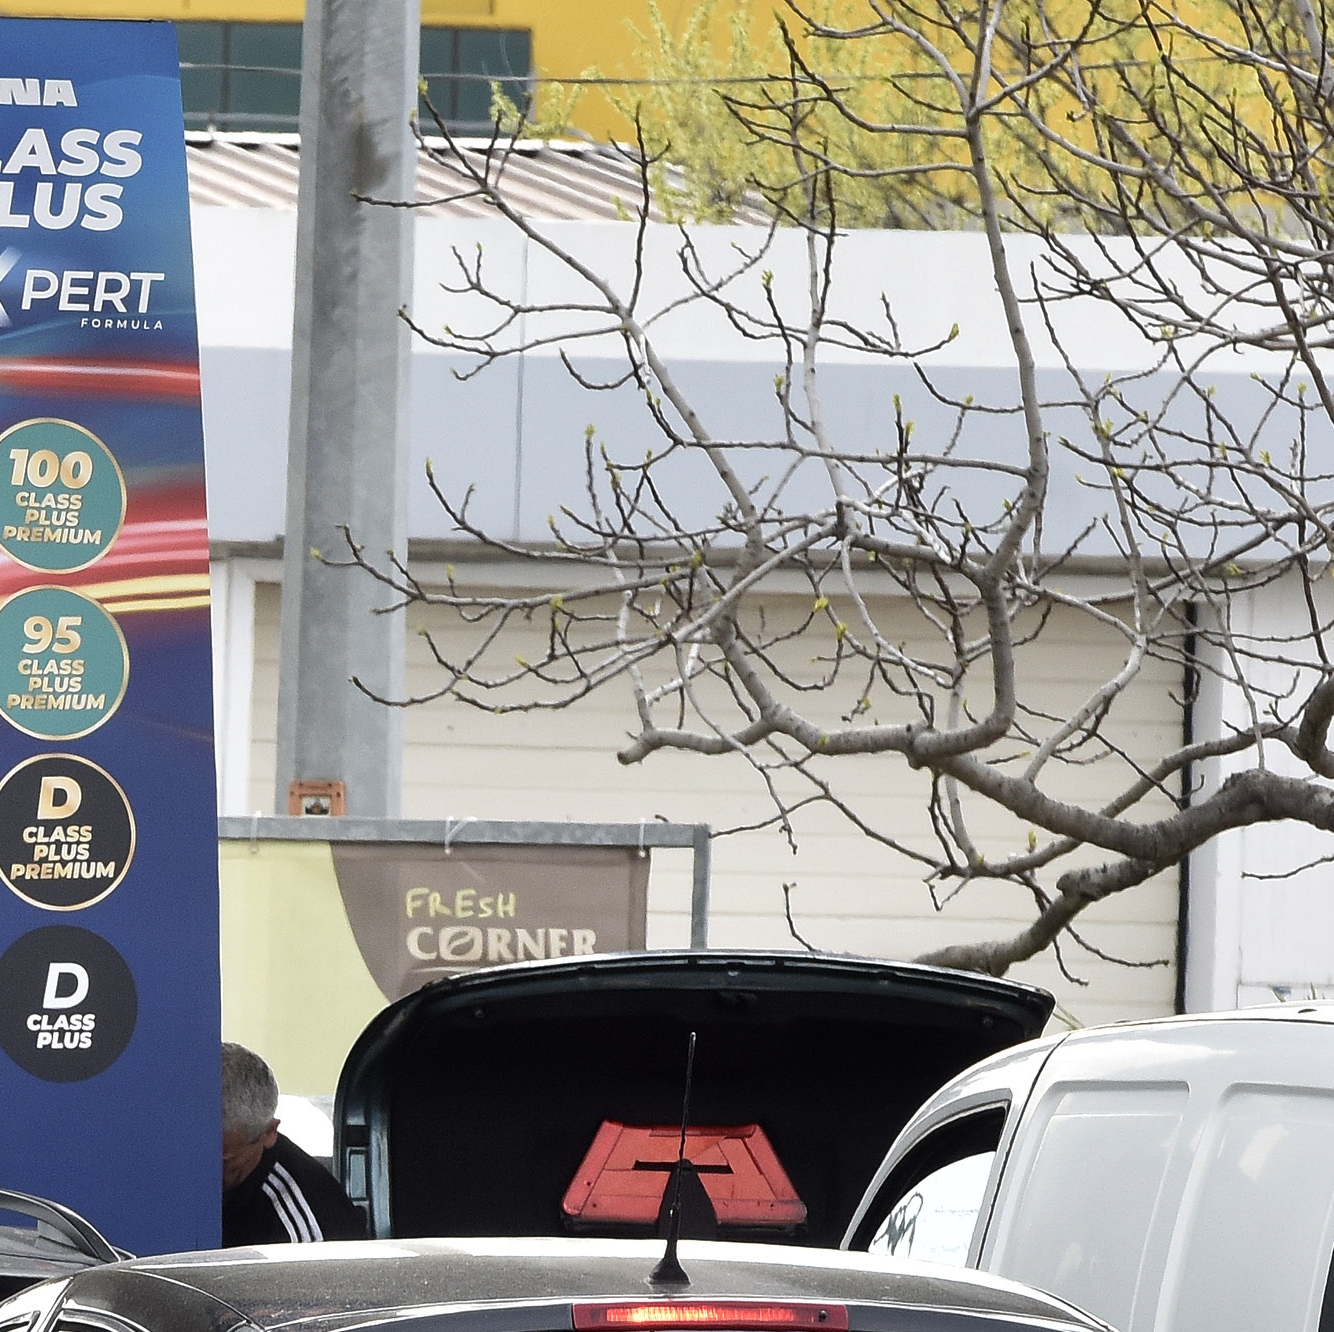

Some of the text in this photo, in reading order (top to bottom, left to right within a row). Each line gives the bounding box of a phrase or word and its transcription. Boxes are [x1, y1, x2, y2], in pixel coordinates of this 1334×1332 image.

[80, 317, 164, 330] FORMULA
[9, 448, 93, 489] 100
[15, 491, 83, 510] CLASS
[24, 509, 79, 527] PLUS
[2, 525, 103, 545] PREMIUM
[22, 615, 83, 654] 95
[17, 659, 85, 677] CLASS
[28, 676, 82, 693] PLUS
[6, 693, 106, 711] PREMIUM
[37, 776, 82, 821] D
[22, 825, 92, 843] CLASS
[33, 843, 90, 862] PLUS
[10, 861, 116, 880] PREMIUM
[405, 887, 517, 919] FRESH
[42, 962, 90, 1010] D
[26, 1013, 96, 1031] CLASS
[36, 1031, 93, 1050] PLUS
